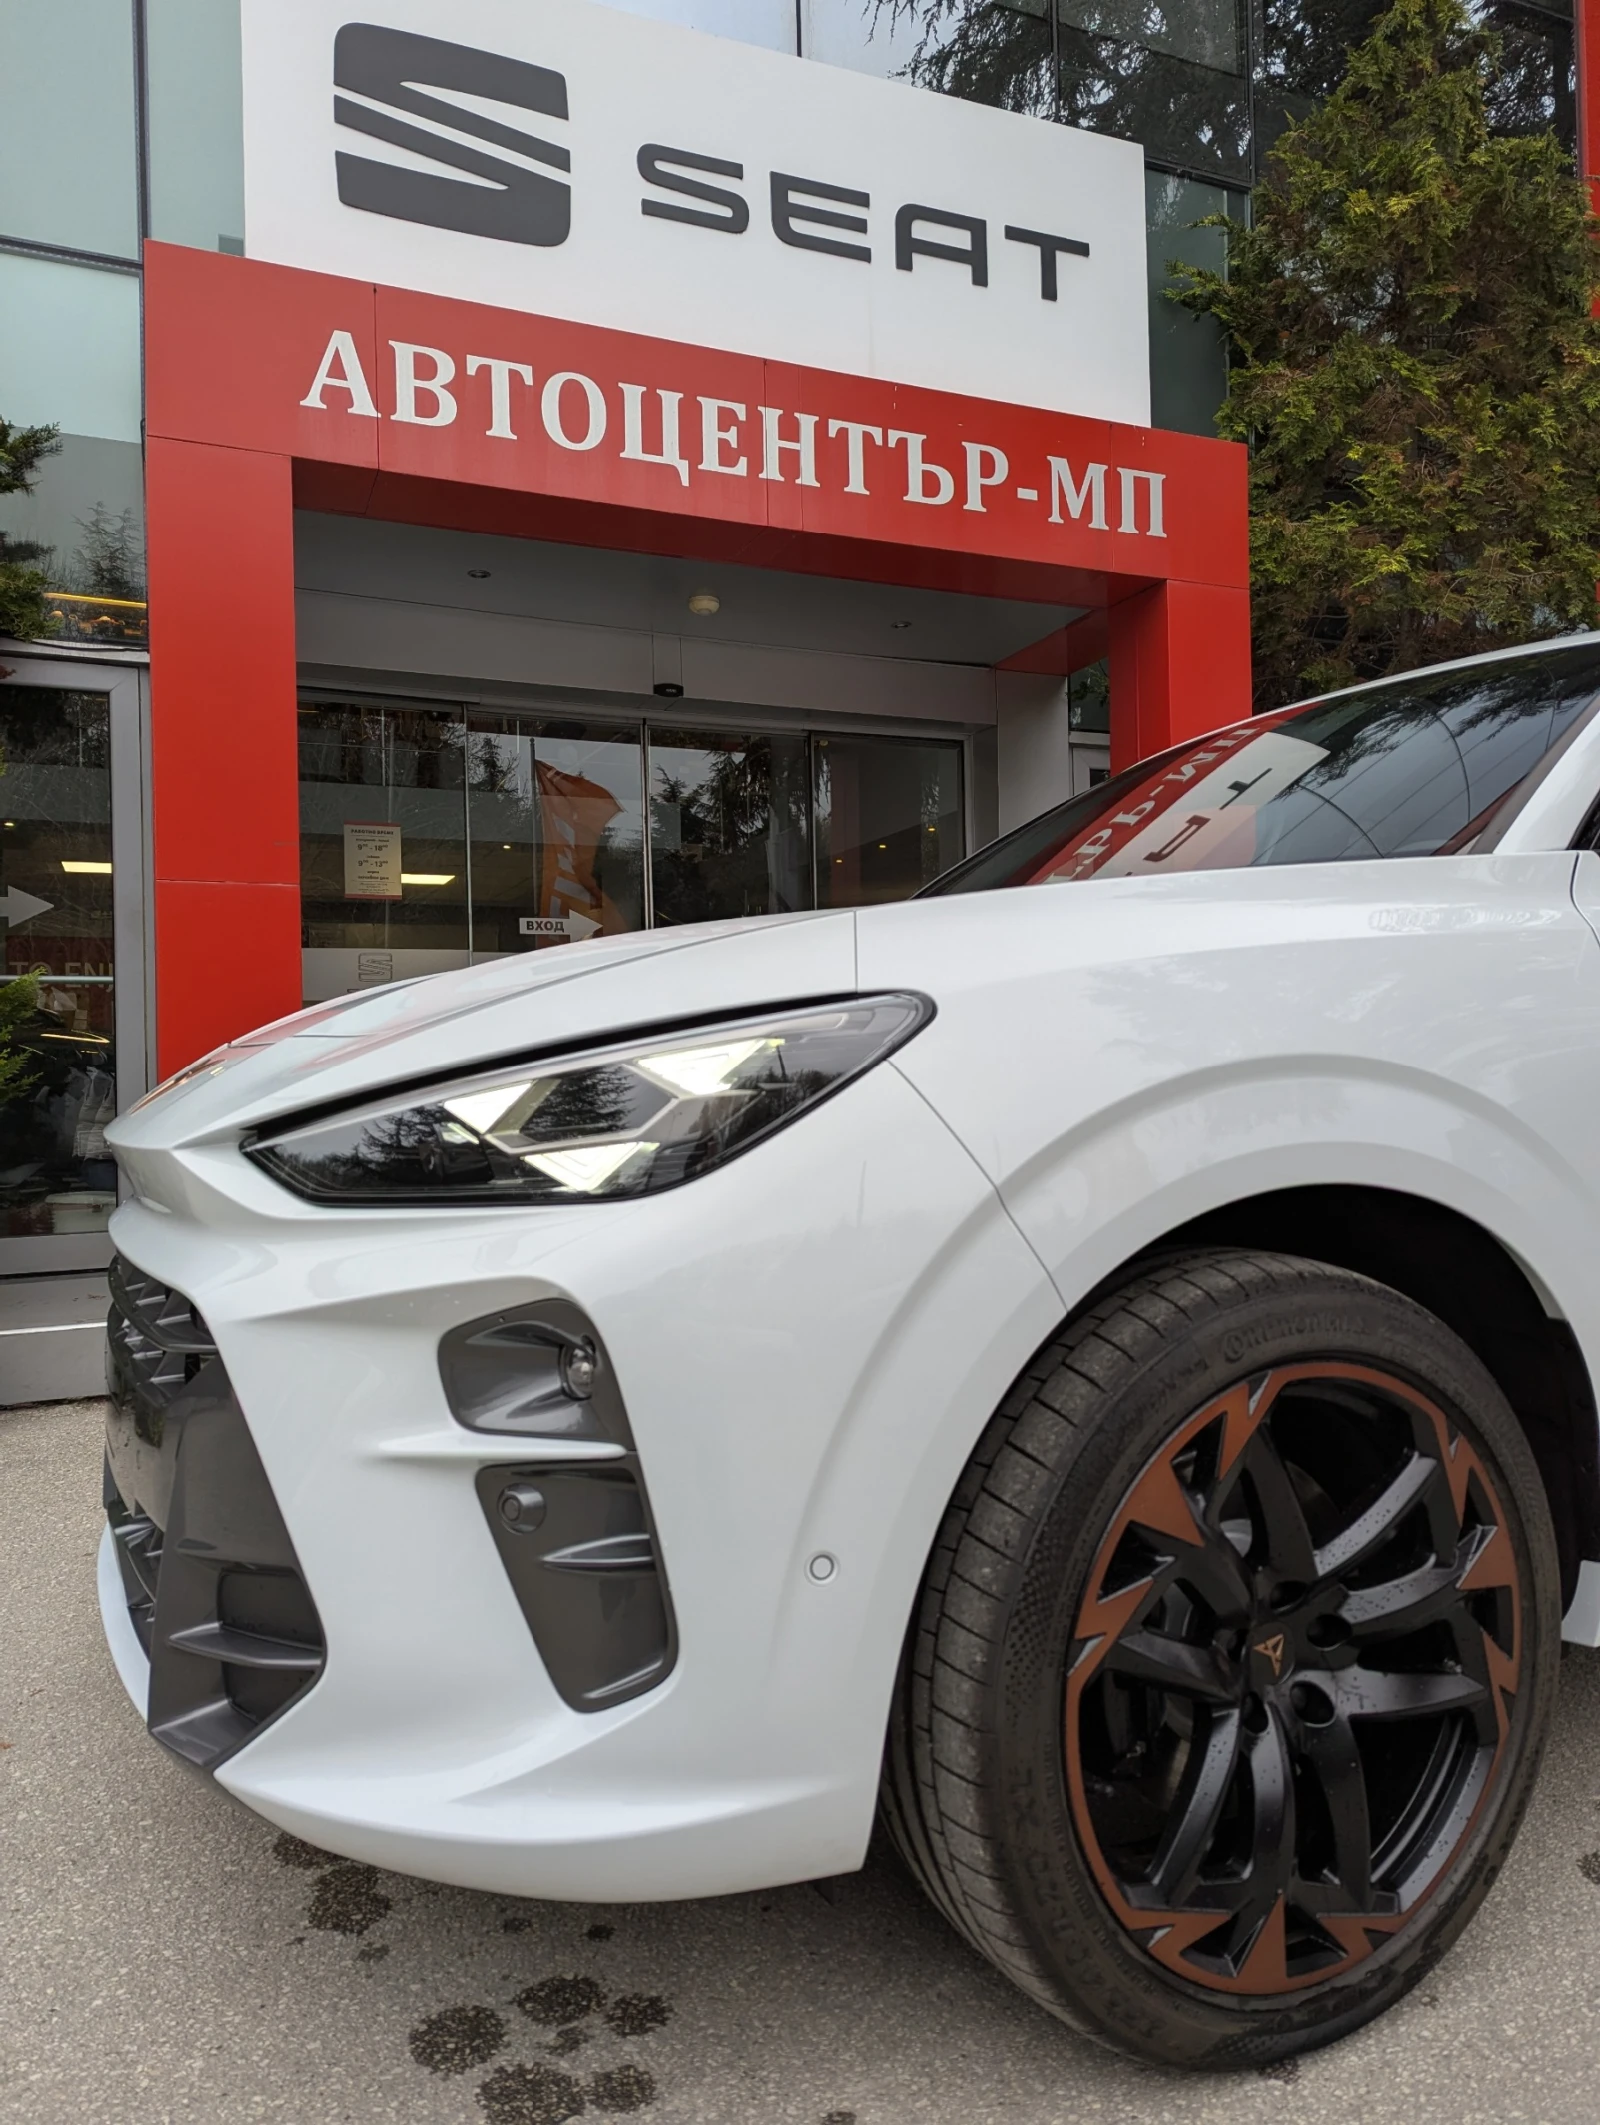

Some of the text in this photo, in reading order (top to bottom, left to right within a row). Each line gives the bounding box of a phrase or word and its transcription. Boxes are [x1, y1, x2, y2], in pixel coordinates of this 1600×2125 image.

[637, 143, 1090, 302] SEAT
[300, 330, 1168, 538] АВТОЦЕНТЪР-МП
[526, 920, 565, 932] ВХОД
